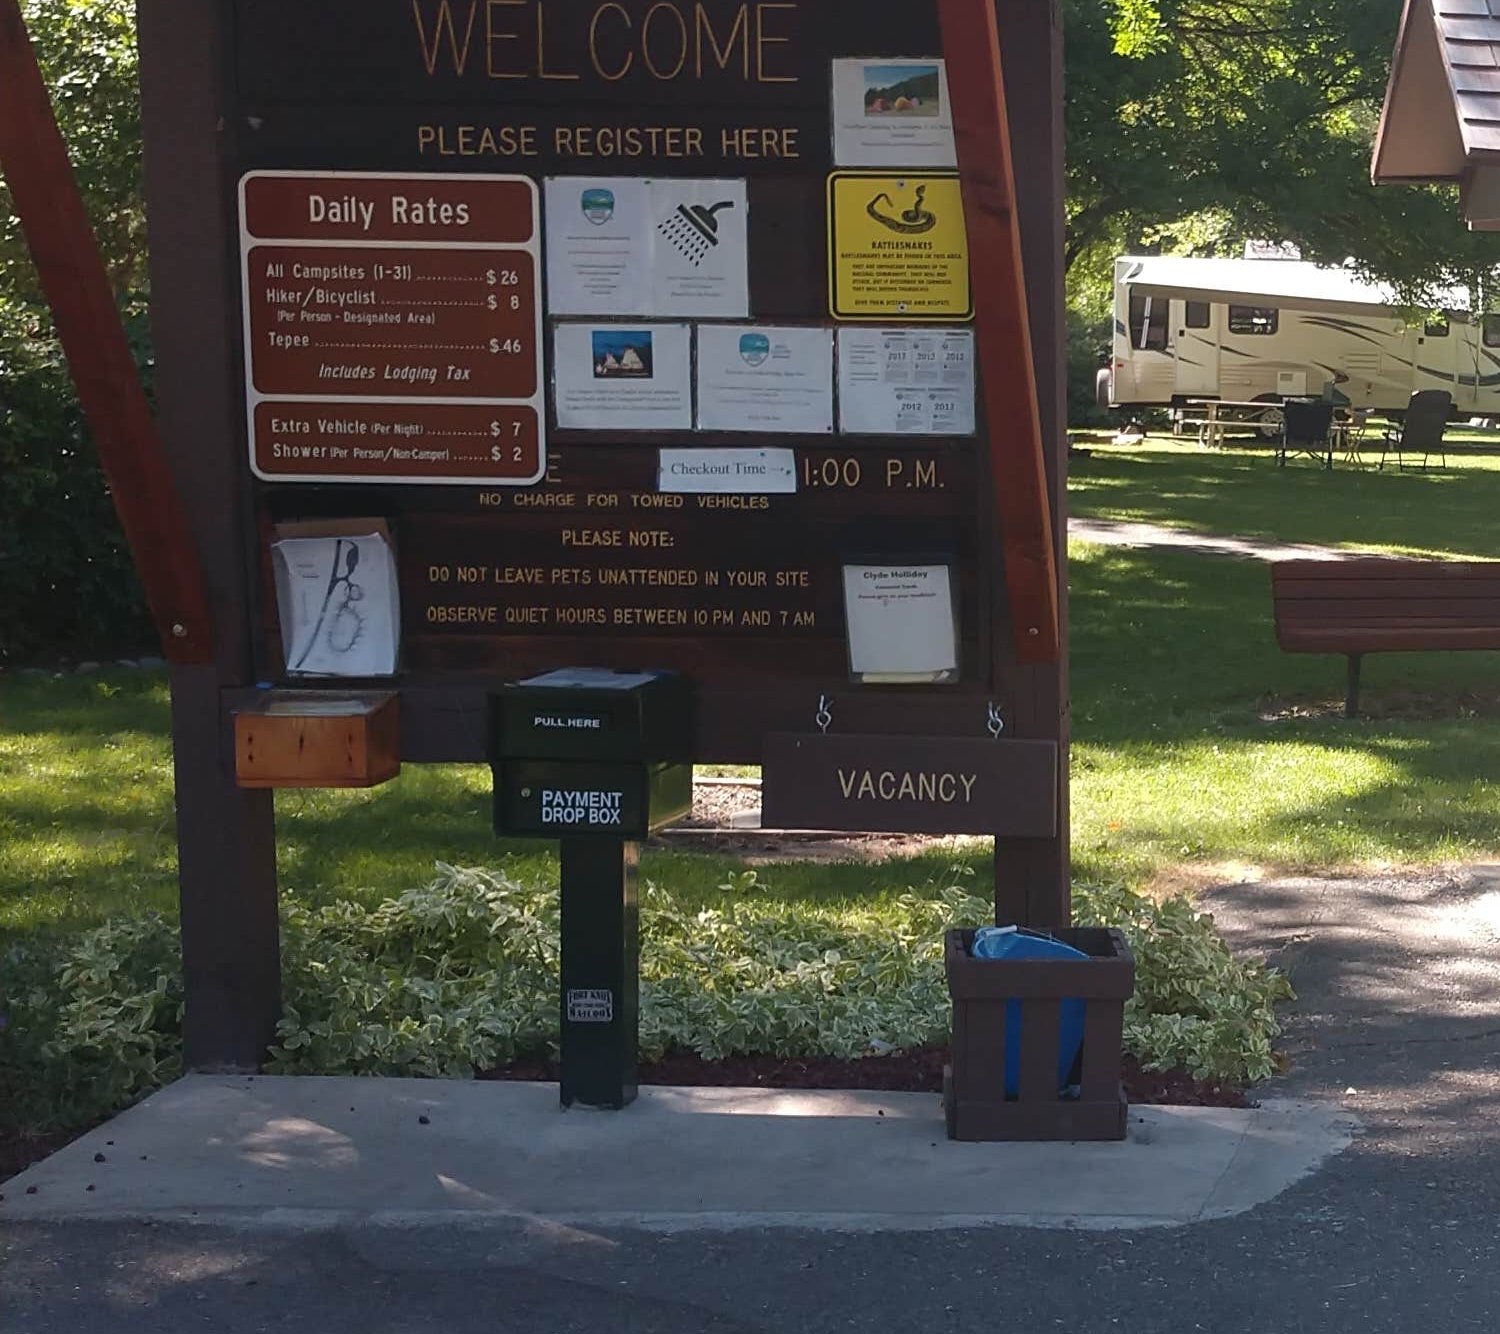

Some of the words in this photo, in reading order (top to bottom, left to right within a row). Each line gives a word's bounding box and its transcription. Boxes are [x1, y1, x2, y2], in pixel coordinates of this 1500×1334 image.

[418, 126, 537, 156] PLEASE
[555, 127, 704, 158] REGISTER
[721, 129, 800, 158] HERE
[309, 195, 374, 230] Daily
[391, 196, 470, 225] Rates
[871, 241, 933, 250] RATTLESNAKES
[266, 264, 283, 278] All
[293, 264, 365, 281] Campsites
[374, 265, 412, 281] (1-31)
[266, 286, 376, 307] Hiker/Bicyclist
[300, 311, 331, 322] Person
[344, 311, 400, 325] Designated
[407, 312, 435, 324] Area)
[268, 331, 309, 349] Tepee
[319, 365, 376, 379] Includes
[384, 365, 437, 383] Lodging
[446, 367, 471, 381] Tax
[271, 419, 309, 433] Extra
[318, 420, 367, 434] Vehicle
[273, 443, 326, 458] Shower
[671, 462, 732, 476] Checkout
[735, 462, 767, 476] Time
[886, 459, 945, 488] P.M.
[479, 493, 501, 506] NO
[514, 493, 576, 507] CHARGE
[588, 494, 619, 507] FOR
[631, 494, 683, 508] TOWED
[698, 495, 769, 509] VEHICLES
[562, 530, 622, 547] PLEASE
[629, 530, 675, 547] NOTE:
[429, 567, 450, 583] DO
[458, 567, 488, 584] NOT
[496, 567, 544, 584] LEAVE
[551, 568, 592, 585] PETS
[599, 568, 698, 586] UNATTENDED
[705, 570, 719, 586] IN
[727, 570, 768, 587] YOUR
[775, 571, 809, 587] SITE
[863, 571, 889, 581] Clyde
[427, 606, 497, 623] OBSERVE
[505, 607, 549, 624] QUIET
[556, 607, 607, 624] HOURS
[614, 608, 687, 625] BETWEEN
[712, 609, 734, 625] PM
[741, 609, 771, 626] AND
[780, 610, 788, 626] 7
[793, 610, 816, 626] AM
[567, 718, 601, 728] HERE
[837, 769, 977, 804] VACANCY
[541, 789, 624, 807] PAYMENT
[541, 806, 586, 823] DROP
[588, 807, 622, 825] BOX
